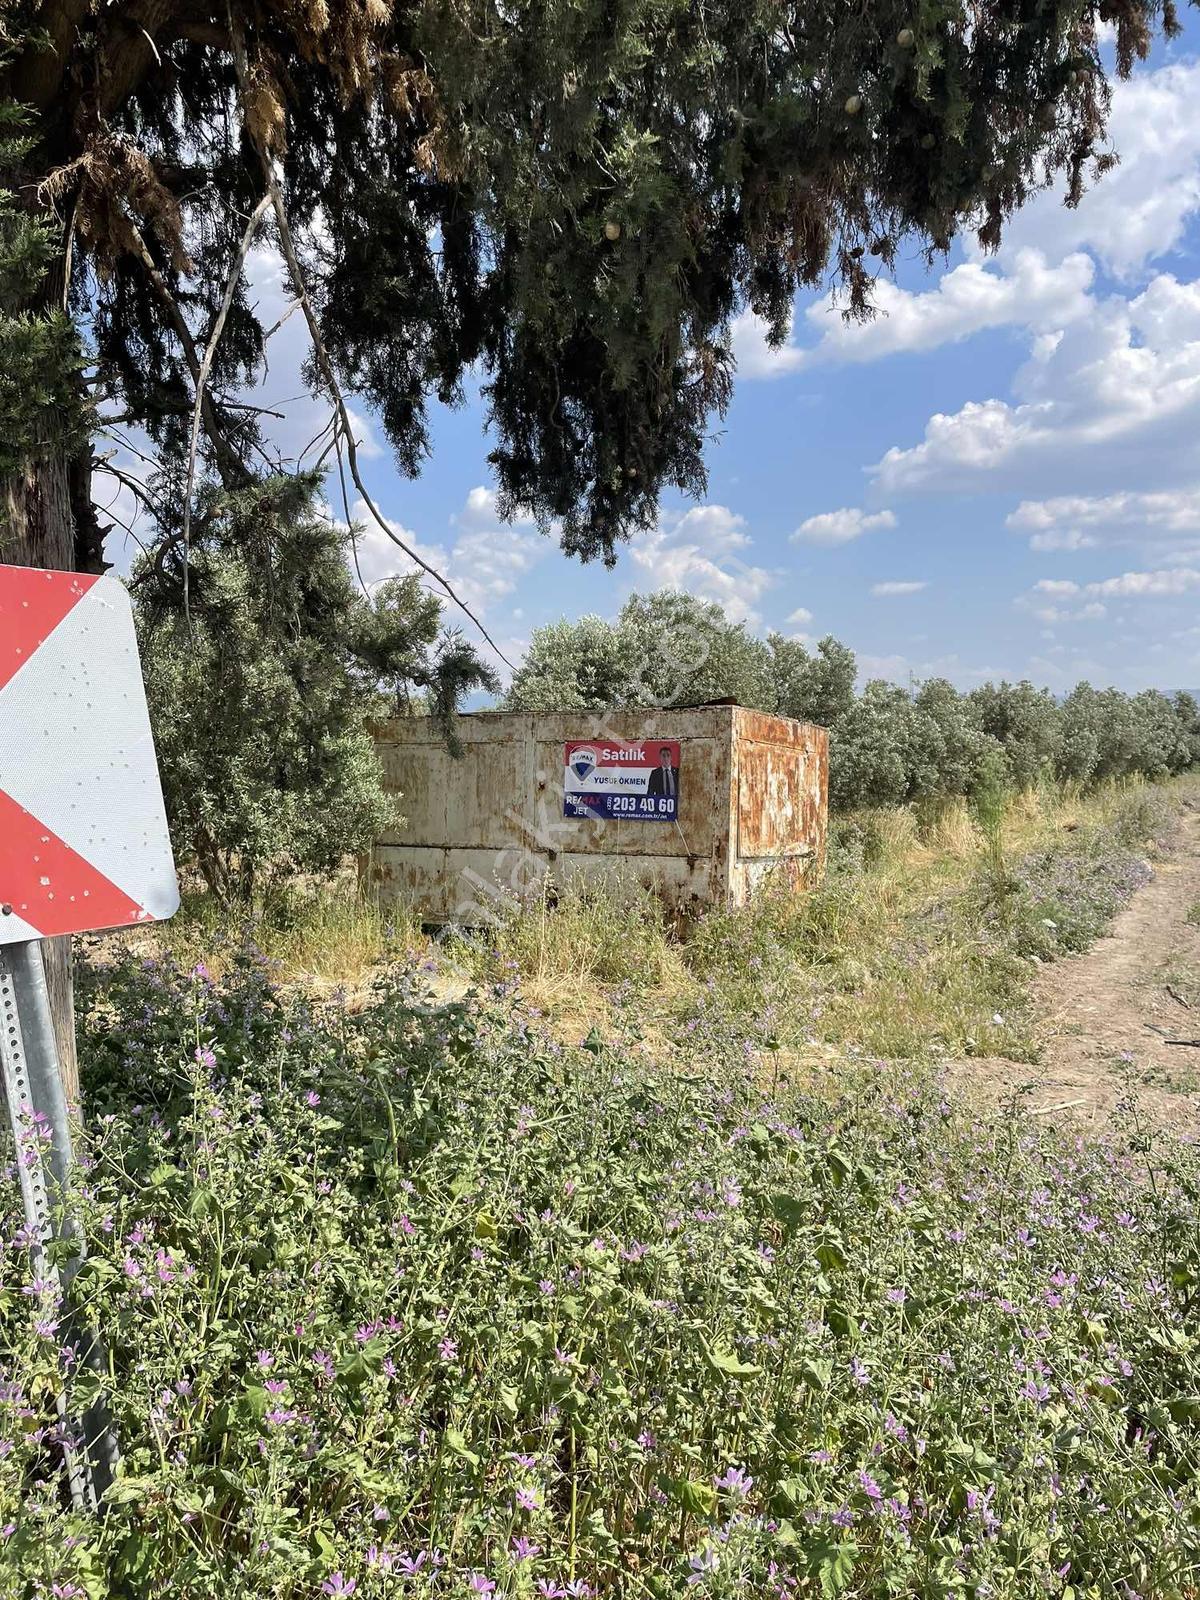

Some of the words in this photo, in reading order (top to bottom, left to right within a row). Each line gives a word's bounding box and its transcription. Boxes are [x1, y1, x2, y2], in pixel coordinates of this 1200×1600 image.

[602, 748, 645, 761] Satılık
[566, 796, 601, 805] RE/MAX
[613, 797, 636, 811] 203
[640, 798, 655, 811] 40
[659, 799, 674, 812] 60
[573, 807, 588, 815] JET
